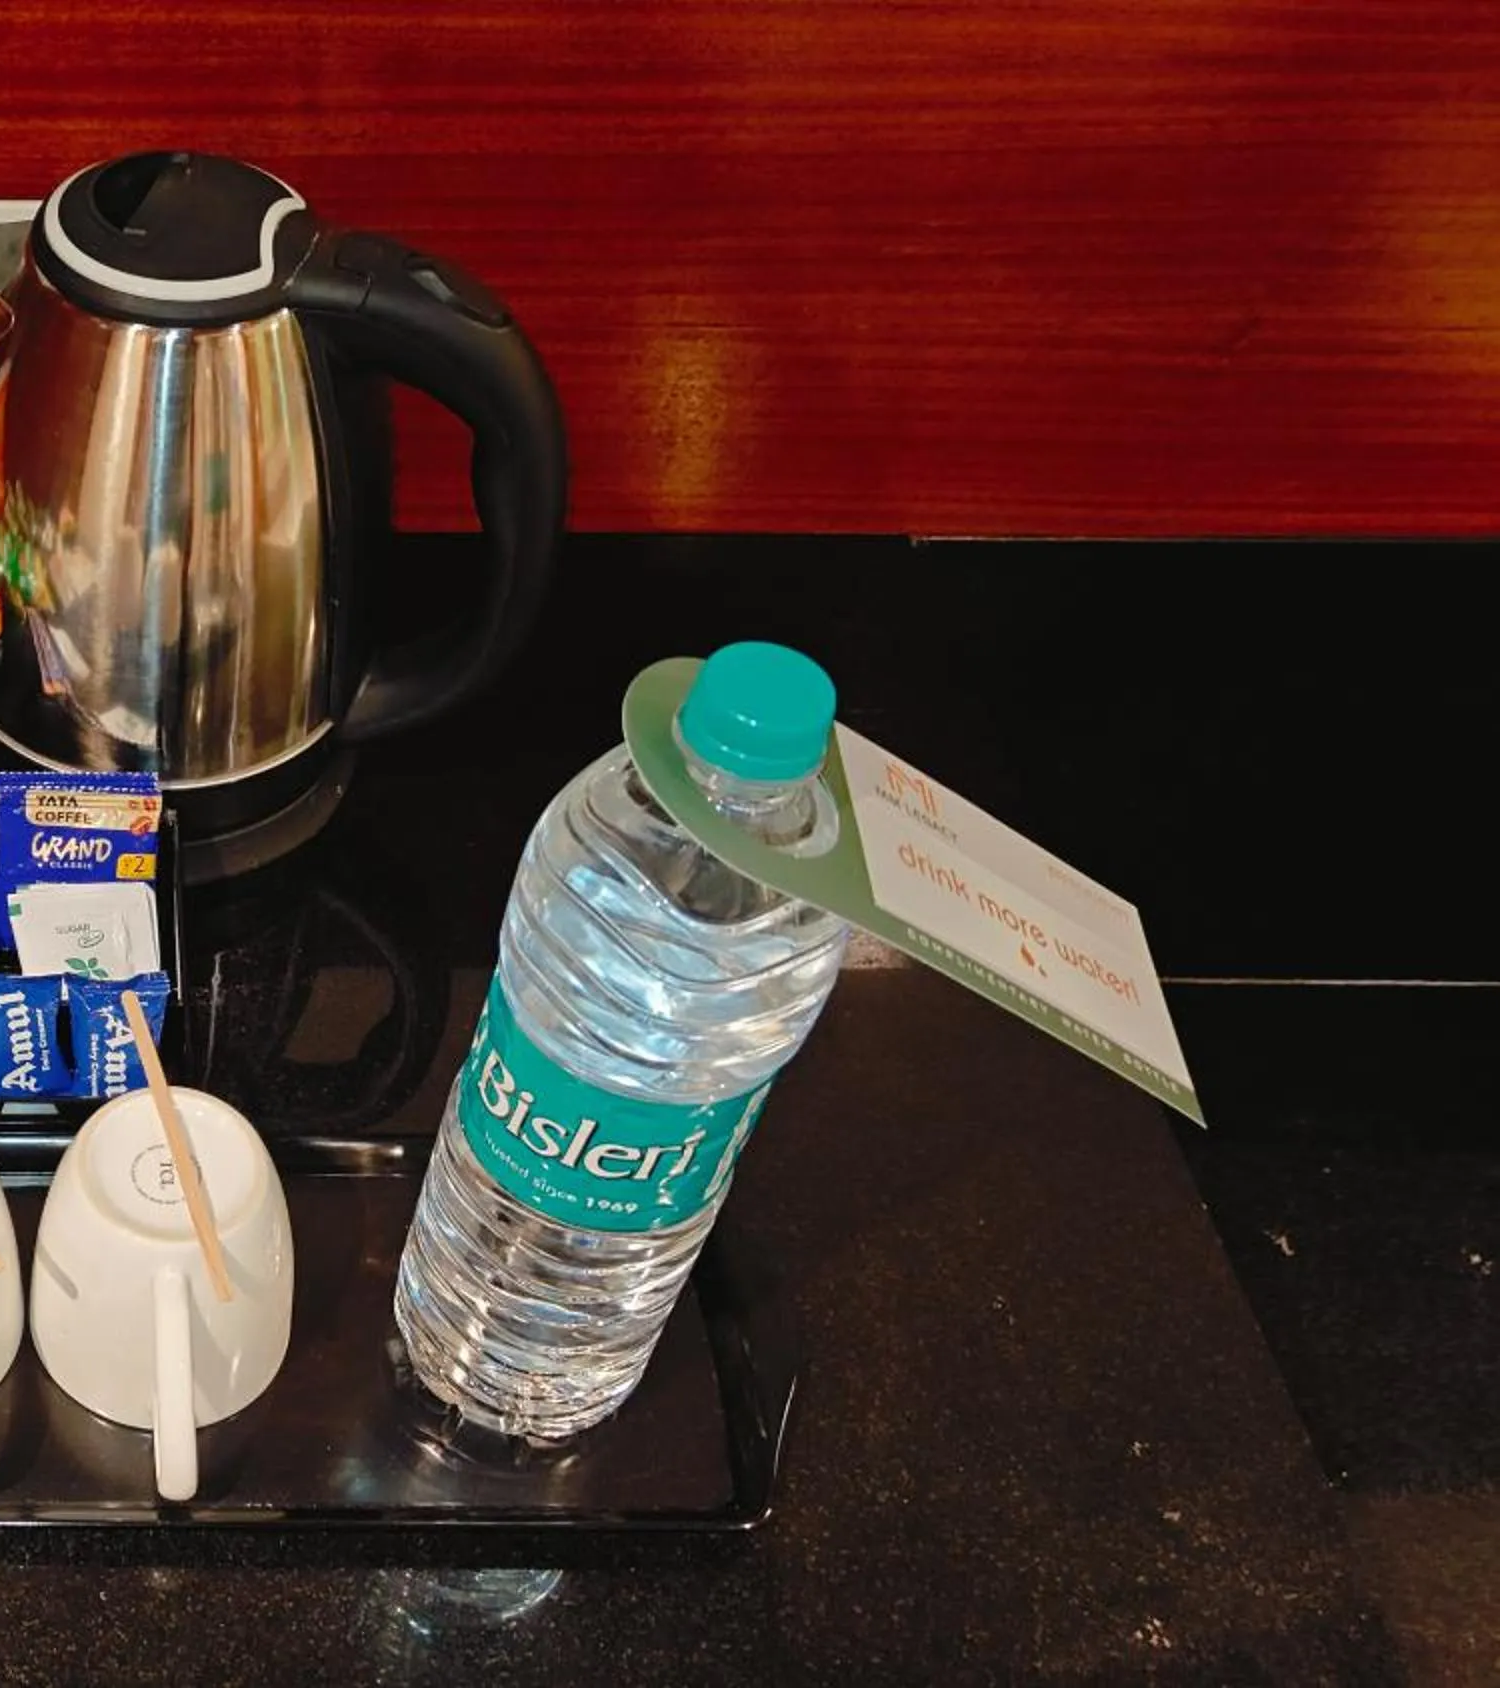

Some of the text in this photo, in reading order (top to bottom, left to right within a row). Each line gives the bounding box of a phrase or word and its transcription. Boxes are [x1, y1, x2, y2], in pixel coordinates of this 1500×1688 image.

[35, 794, 78, 807] TATA
[31, 831, 113, 863] GRAND
[897, 842, 971, 902] drink
[976, 891, 1049, 949] more
[1054, 936, 1142, 1006] water!
[476, 1049, 707, 1182] Bisleri
[585, 1196, 640, 1215] 1969
